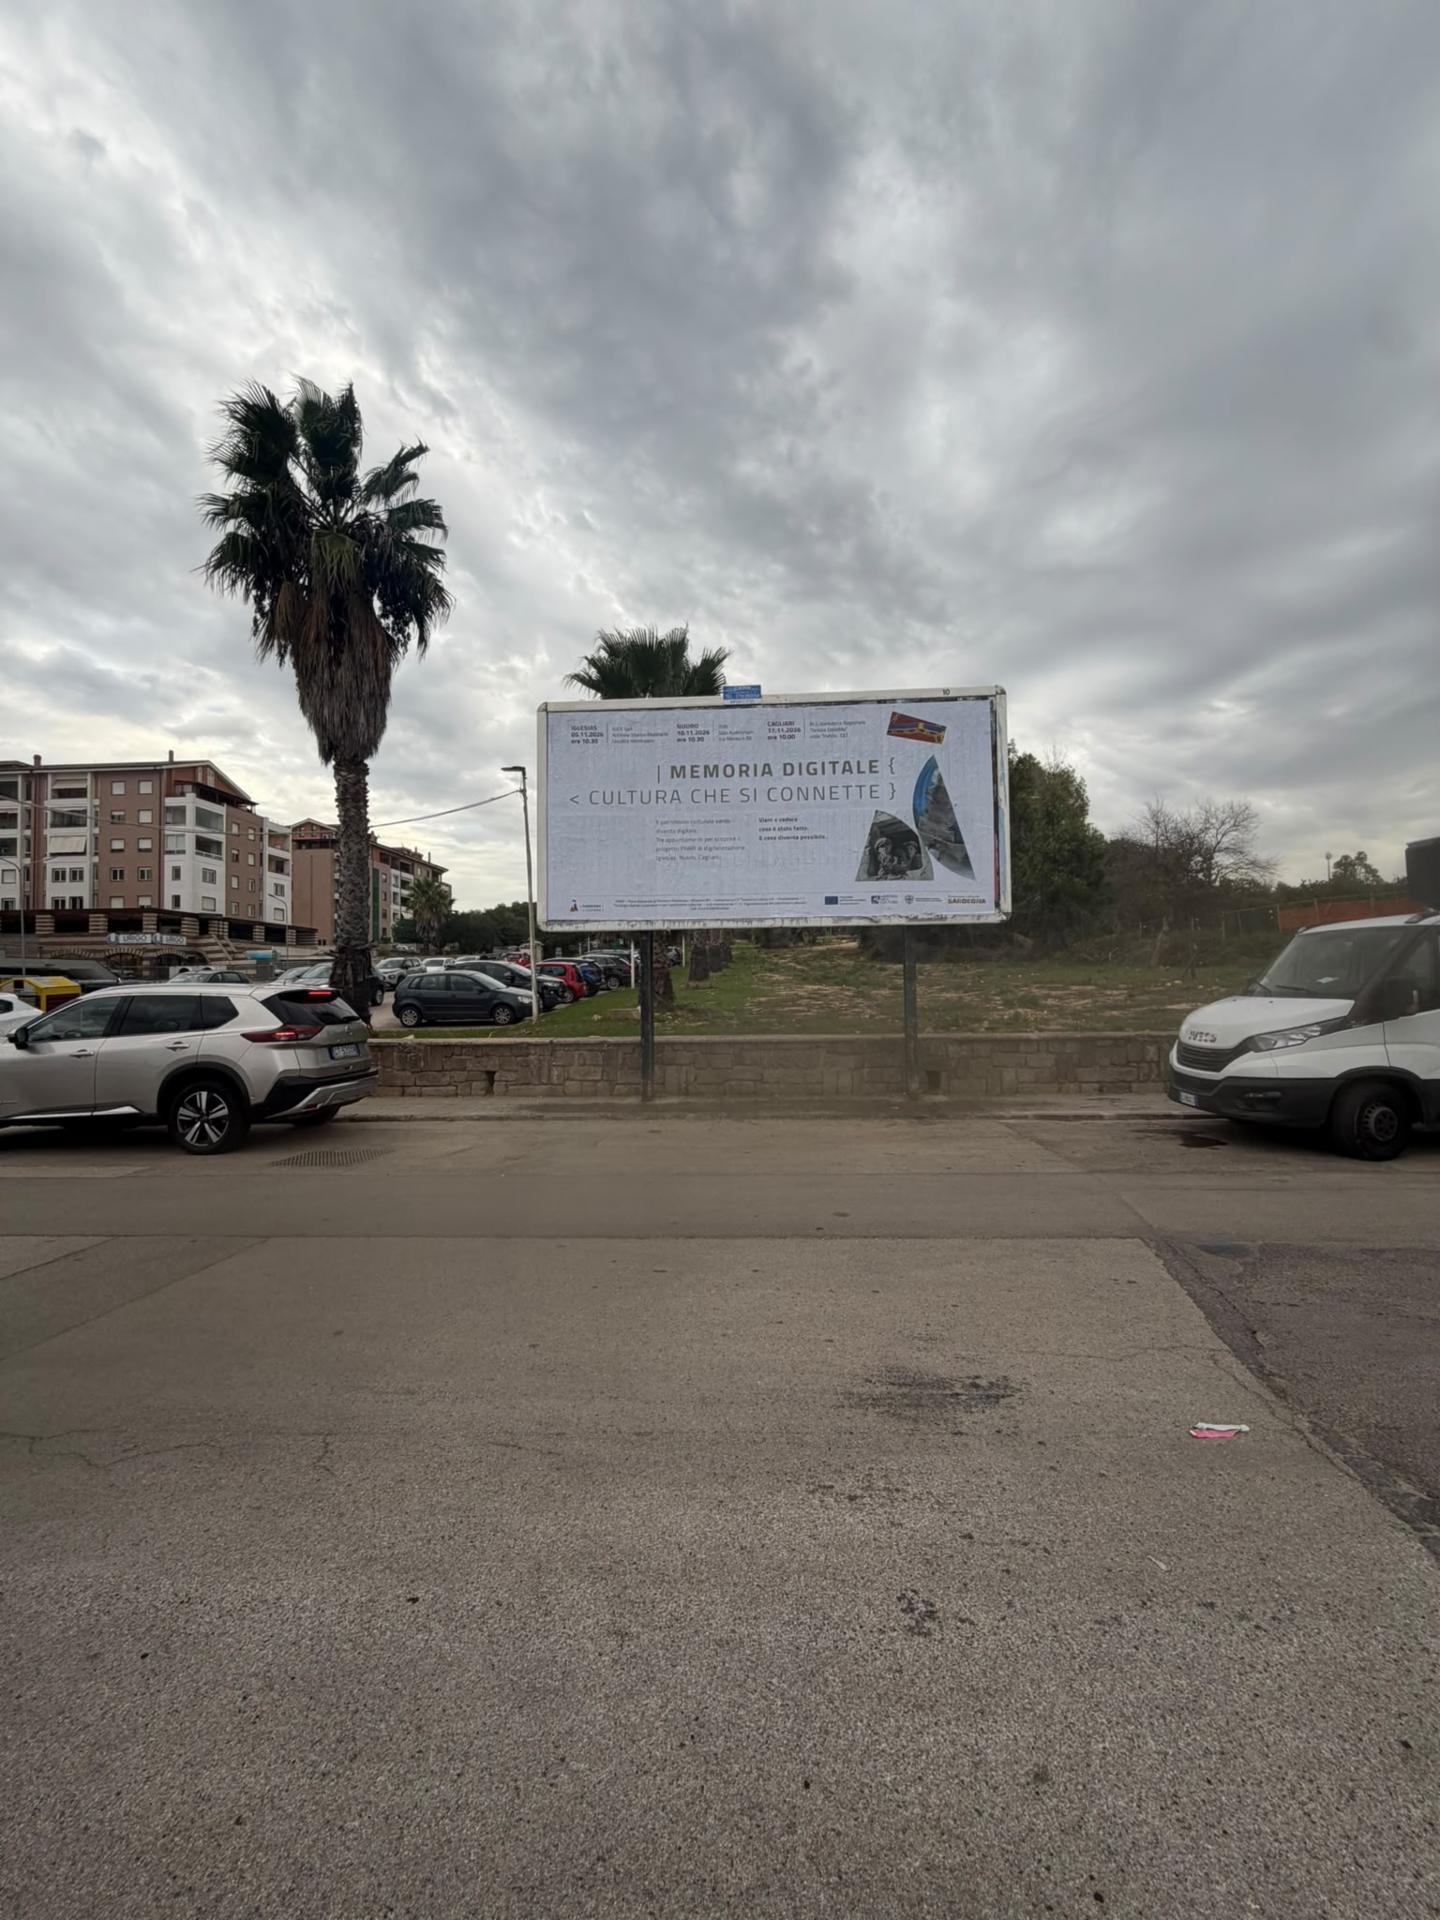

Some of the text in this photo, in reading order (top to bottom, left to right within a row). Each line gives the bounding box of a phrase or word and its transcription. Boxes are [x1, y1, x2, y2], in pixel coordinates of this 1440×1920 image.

[670, 764, 773, 779] MEMORIA
[783, 760, 880, 776] DIGITALE
[589, 789, 682, 805] CULTURA
[690, 787, 731, 804] CHE
[739, 786, 757, 803] SI
[767, 784, 880, 802] CONNETTE
